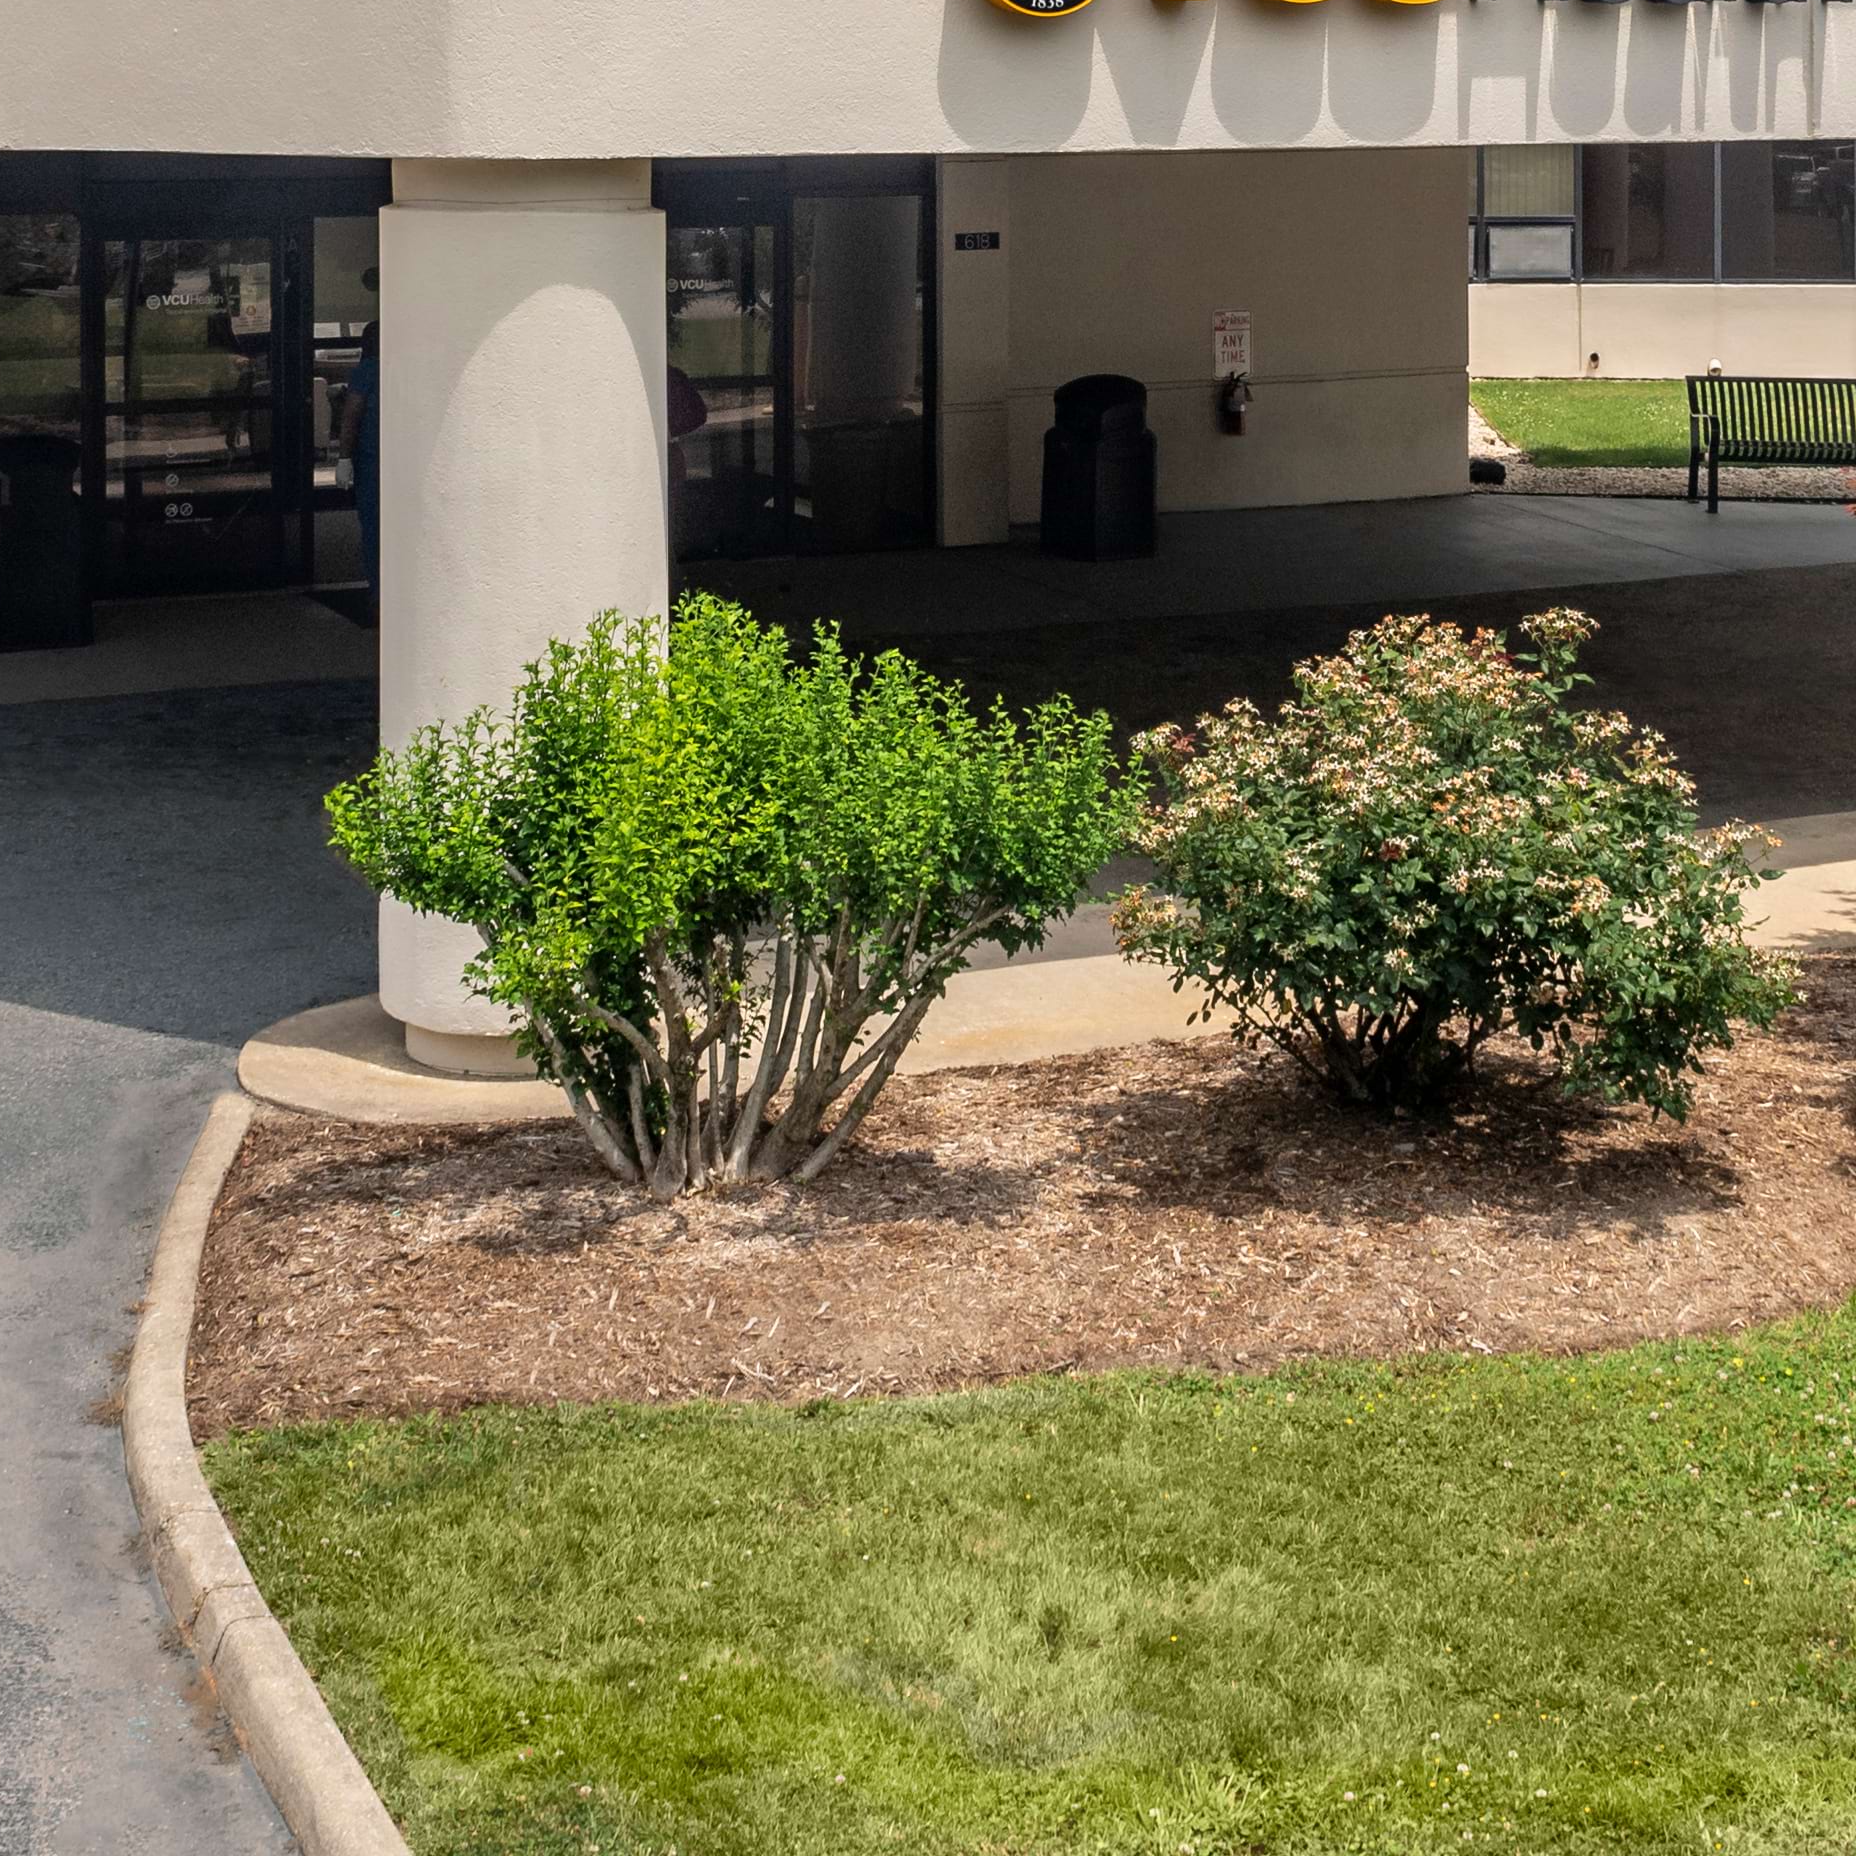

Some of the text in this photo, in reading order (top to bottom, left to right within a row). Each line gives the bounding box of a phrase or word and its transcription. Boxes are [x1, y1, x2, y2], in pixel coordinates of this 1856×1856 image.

[965, 234, 991, 250] 618
[1222, 334, 1244, 348] ANY
[1221, 350, 1246, 364] TIME
